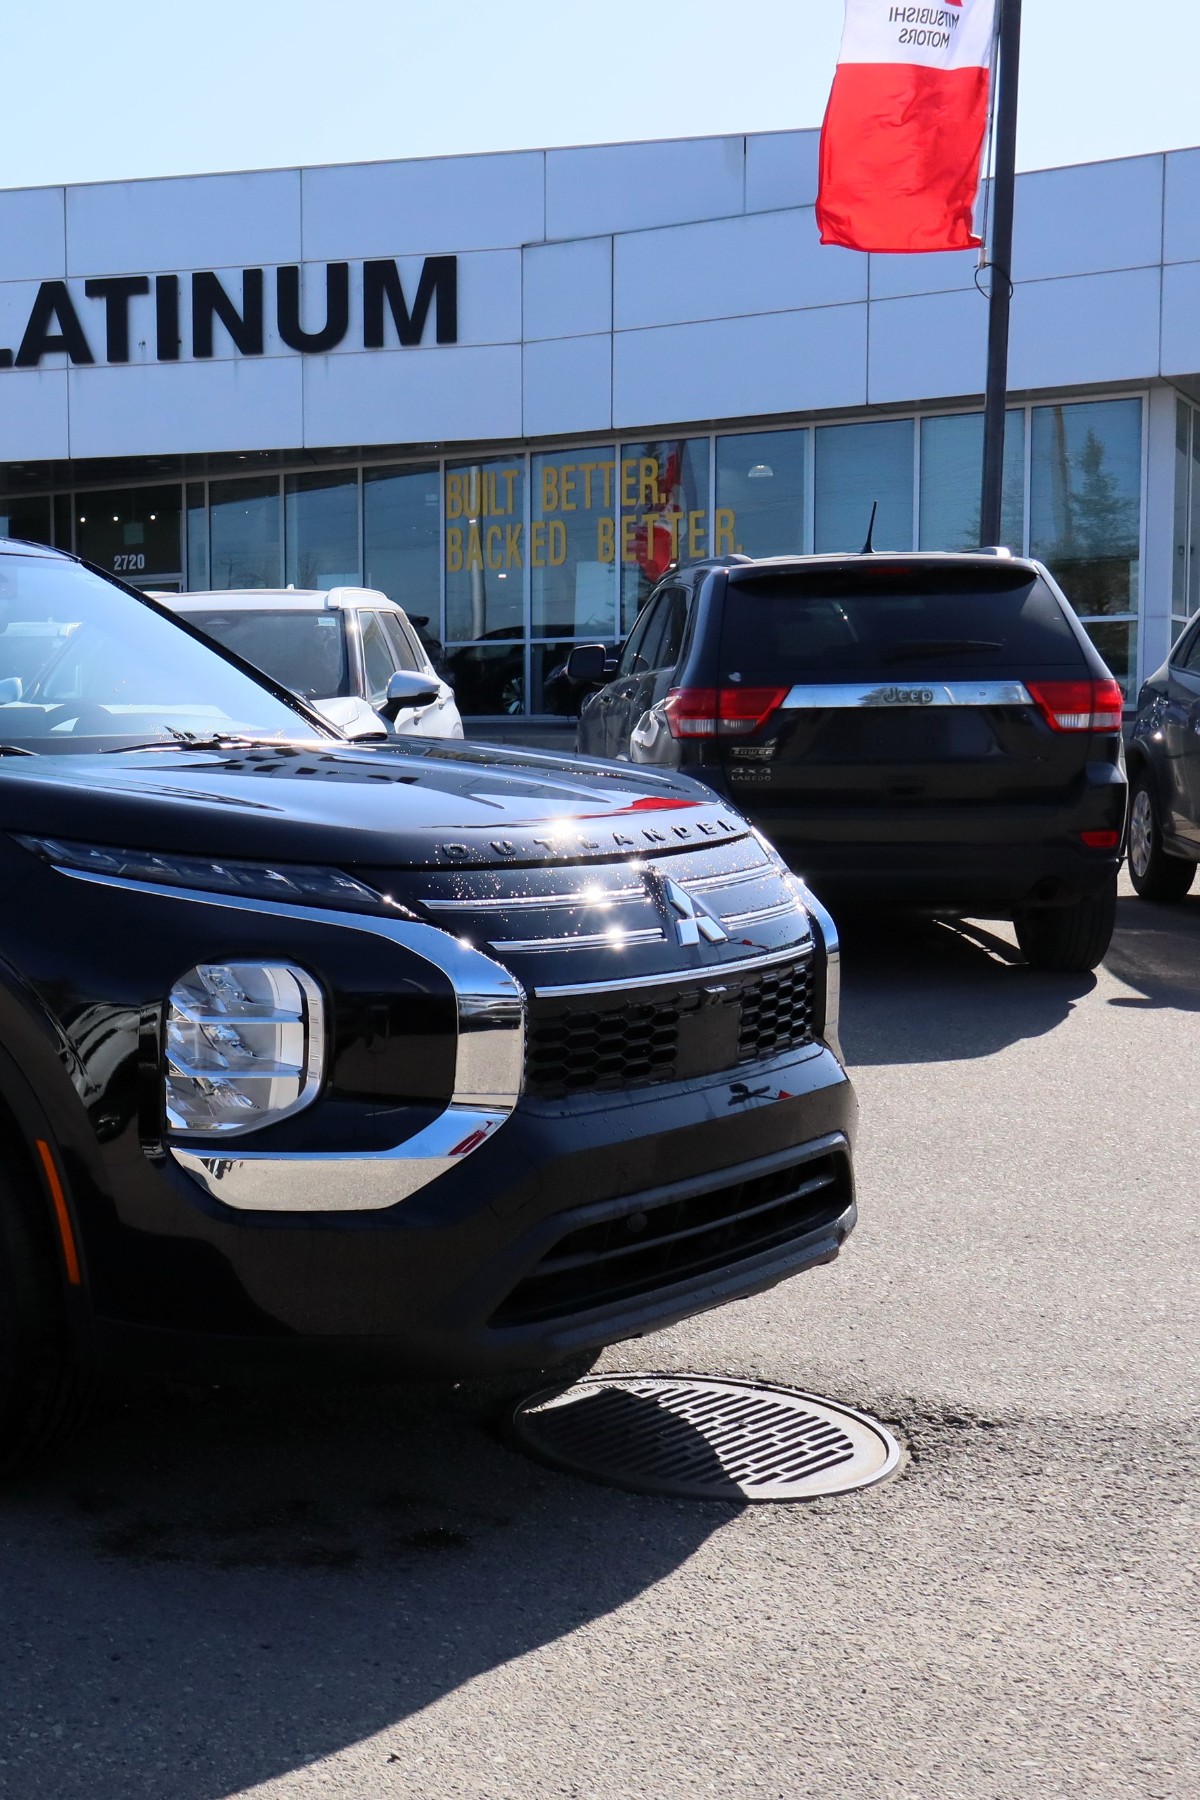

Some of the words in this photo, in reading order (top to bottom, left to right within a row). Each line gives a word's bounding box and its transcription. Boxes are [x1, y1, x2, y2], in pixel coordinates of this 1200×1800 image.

[446, 470, 519, 520] BUILT
[542, 458, 667, 513] BETTER.
[447, 520, 567, 572] BACKED
[597, 508, 744, 563] BETTER.
[113, 553, 145, 571] 2720
[883, 687, 934, 704] Jeep
[442, 819, 739, 860] OUTLANDER
